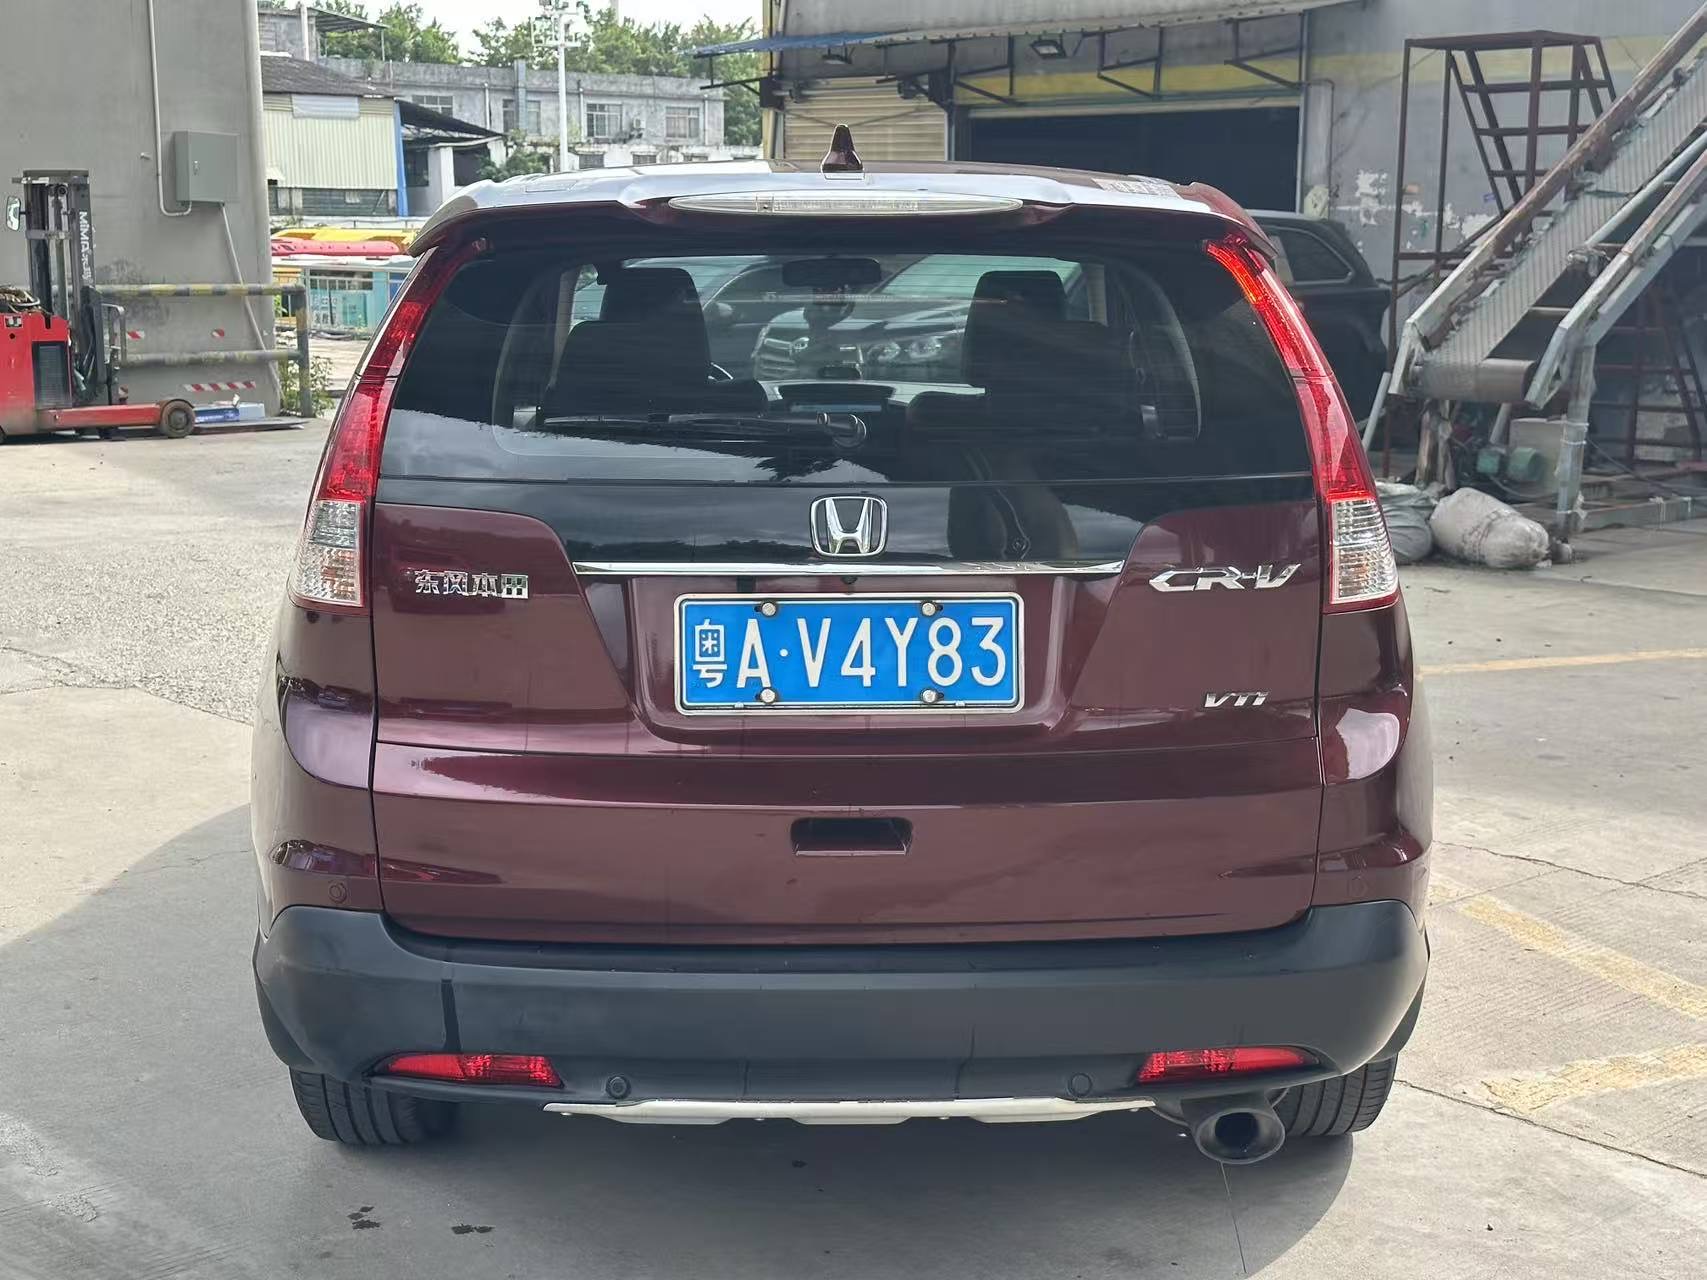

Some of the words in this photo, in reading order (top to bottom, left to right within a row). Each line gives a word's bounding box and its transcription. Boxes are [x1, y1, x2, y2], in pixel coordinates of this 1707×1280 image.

[414, 569, 529, 599] 东风本田
[1149, 563, 1301, 592] CR-V
[692, 617, 1007, 688] 粤A·V4Y83
